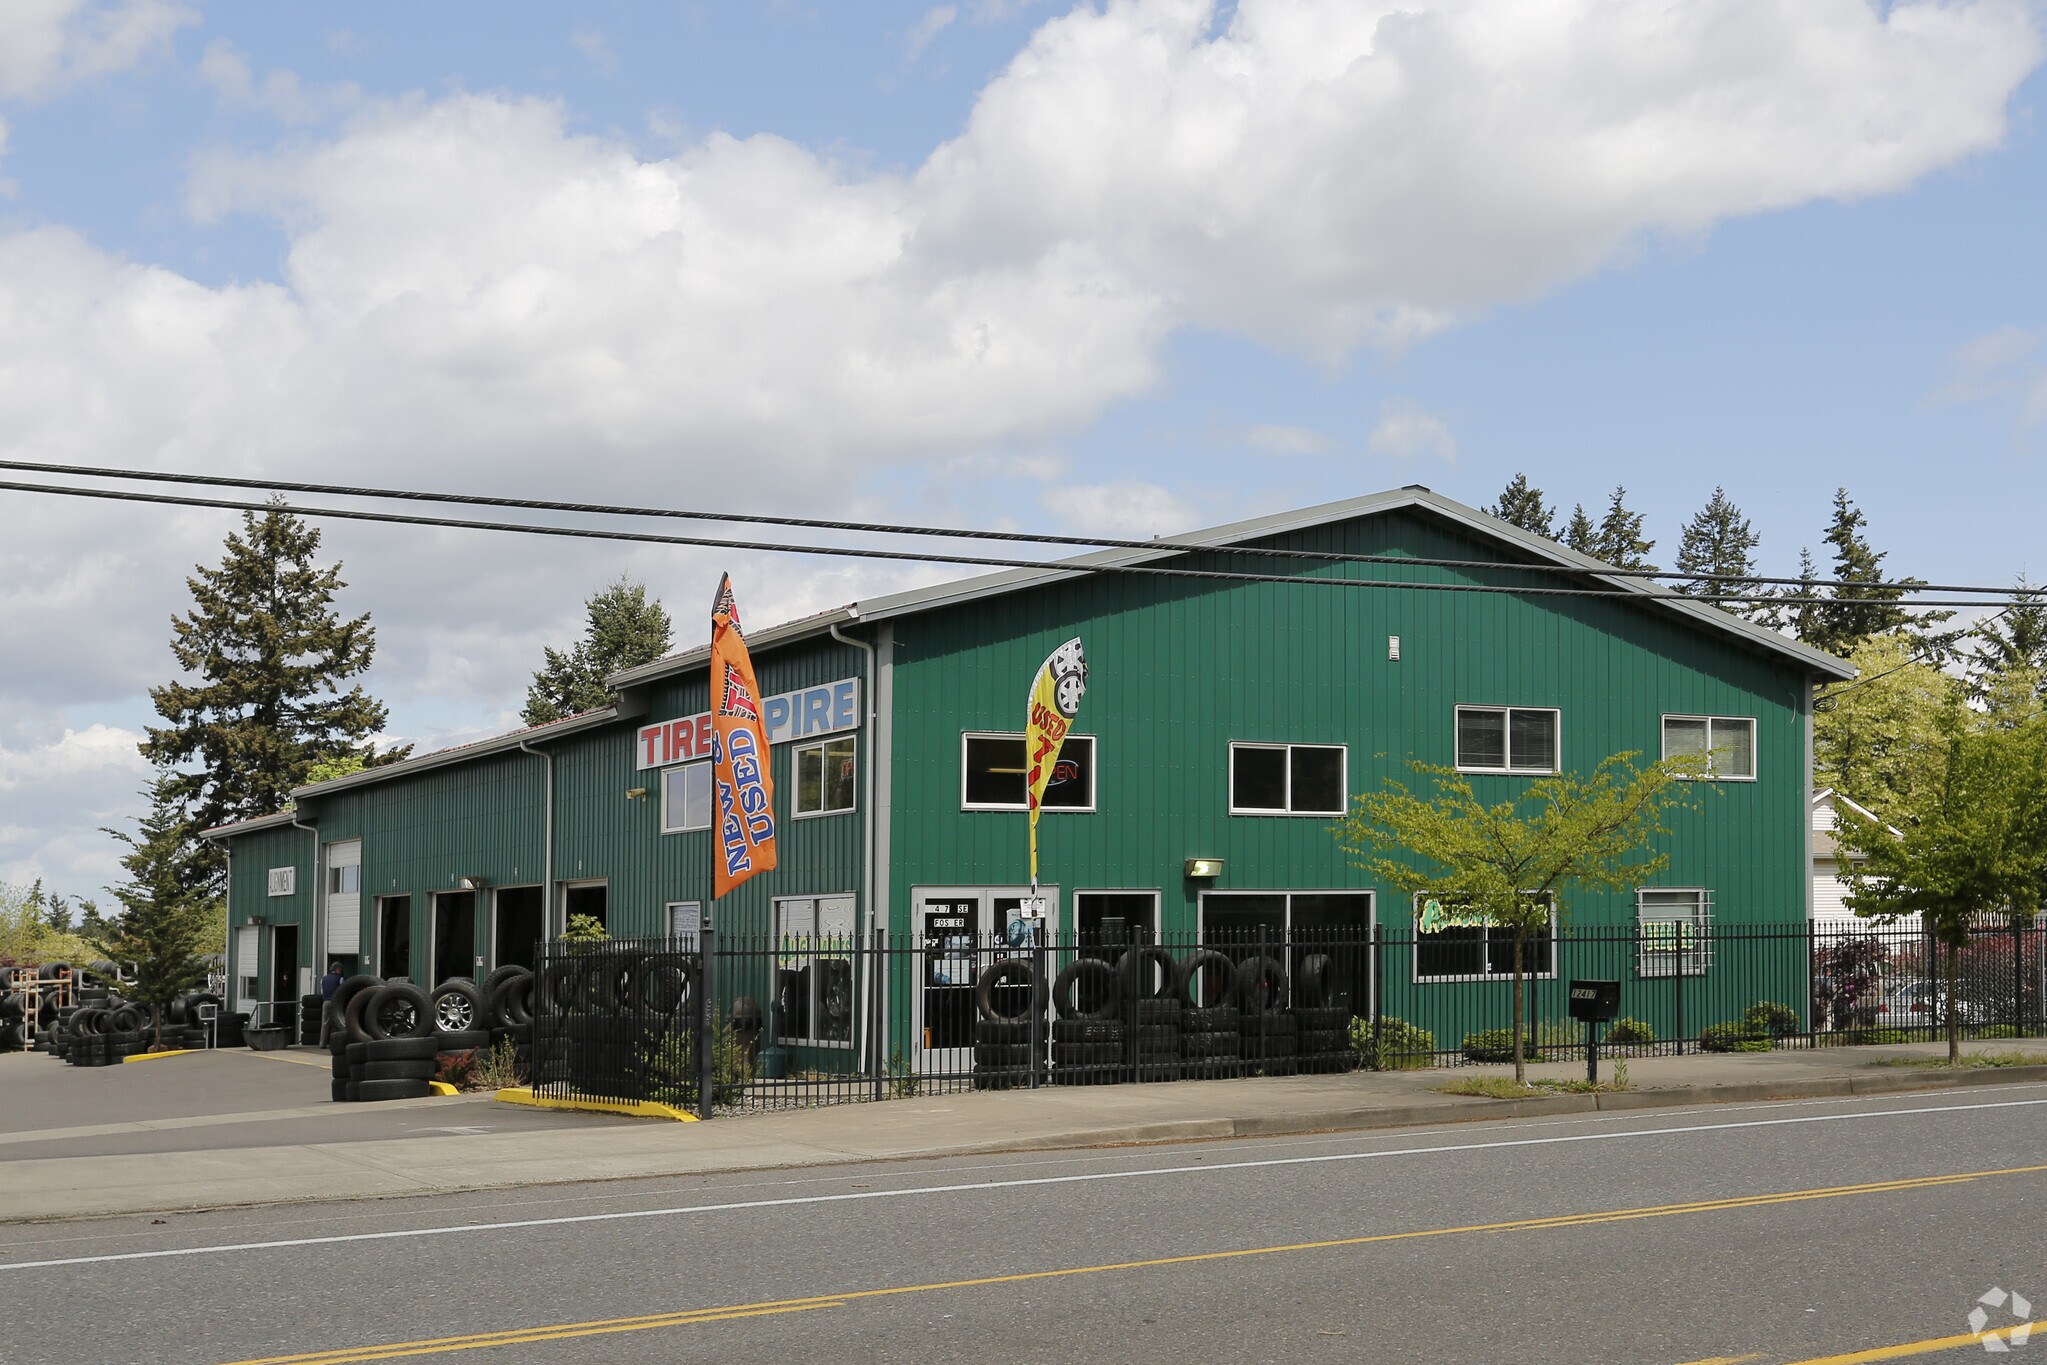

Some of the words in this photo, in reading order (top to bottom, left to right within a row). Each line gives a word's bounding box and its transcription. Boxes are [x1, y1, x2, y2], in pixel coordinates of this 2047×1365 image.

[641, 715, 711, 766] TIRE
[763, 682, 853, 742] PIRE
[1032, 702, 1066, 741] USED
[716, 780, 750, 876] NEW
[727, 728, 775, 846] USED
[958, 905, 968, 913] SE
